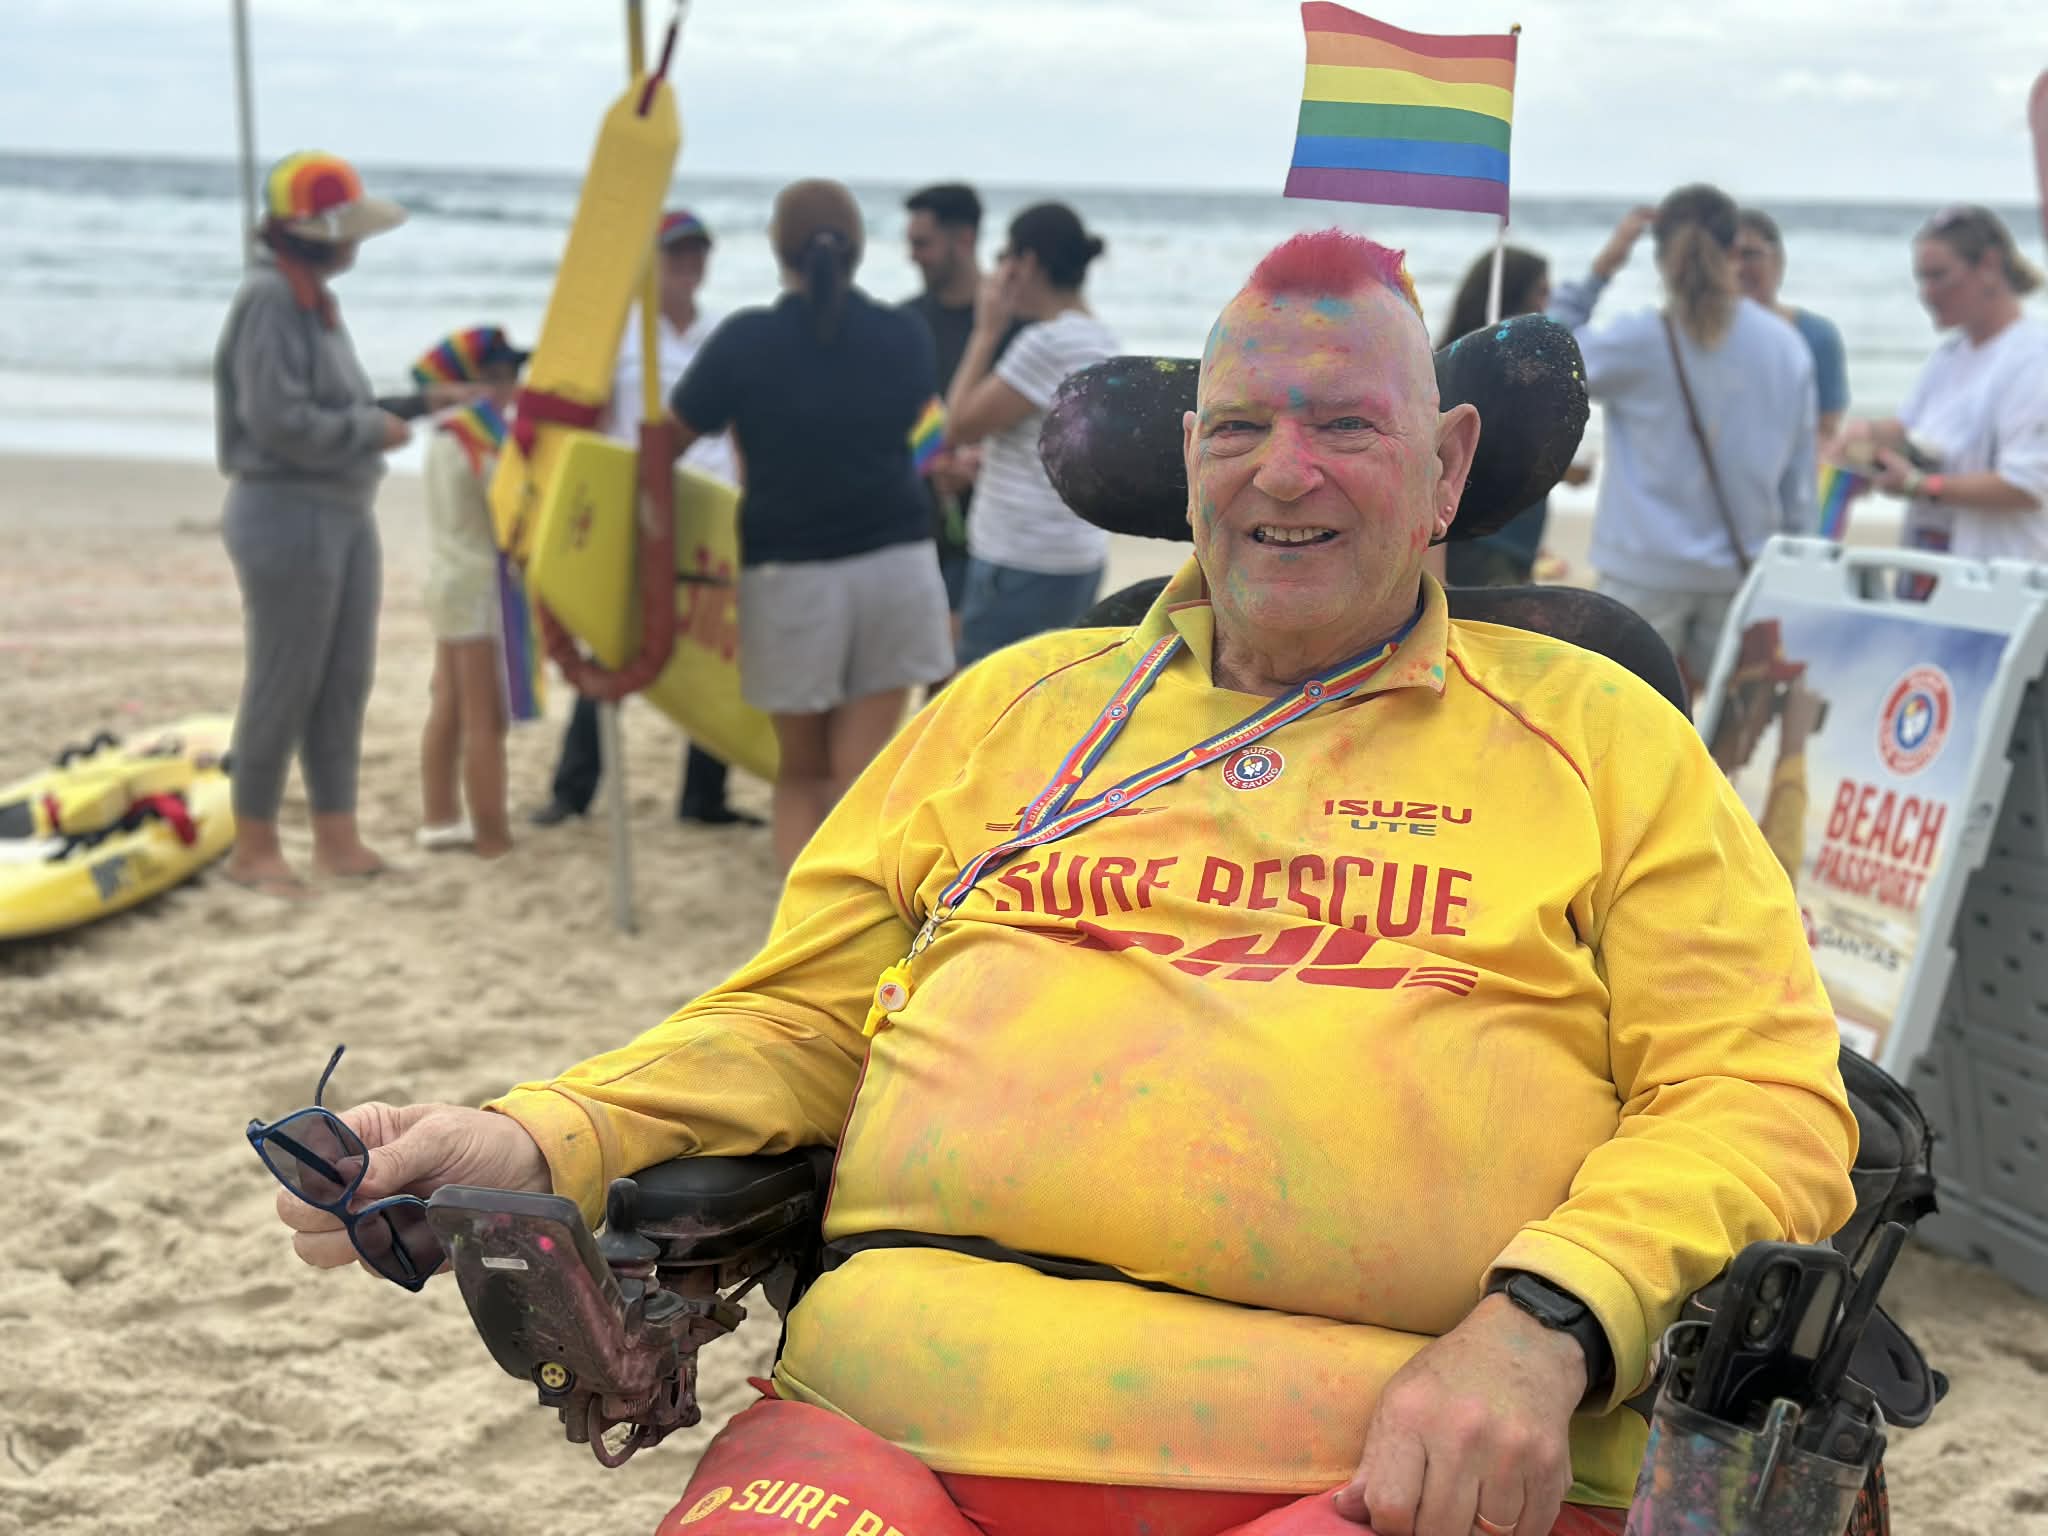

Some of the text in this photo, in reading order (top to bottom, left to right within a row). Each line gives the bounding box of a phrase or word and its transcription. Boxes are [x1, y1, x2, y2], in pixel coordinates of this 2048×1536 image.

[1239, 724, 1265, 741] PRIDE
[1241, 747, 1274, 756] SURF
[1225, 767, 1279, 789] LIFE SAVING
[1324, 799, 1473, 824] ISUZU
[1826, 778, 1948, 868] BEACH
[1350, 819, 1437, 836] UTE
[1811, 844, 1927, 914] PASSPORT
[995, 851, 1473, 937] SURF RESCUE
[728, 1479, 850, 1530] SURF
